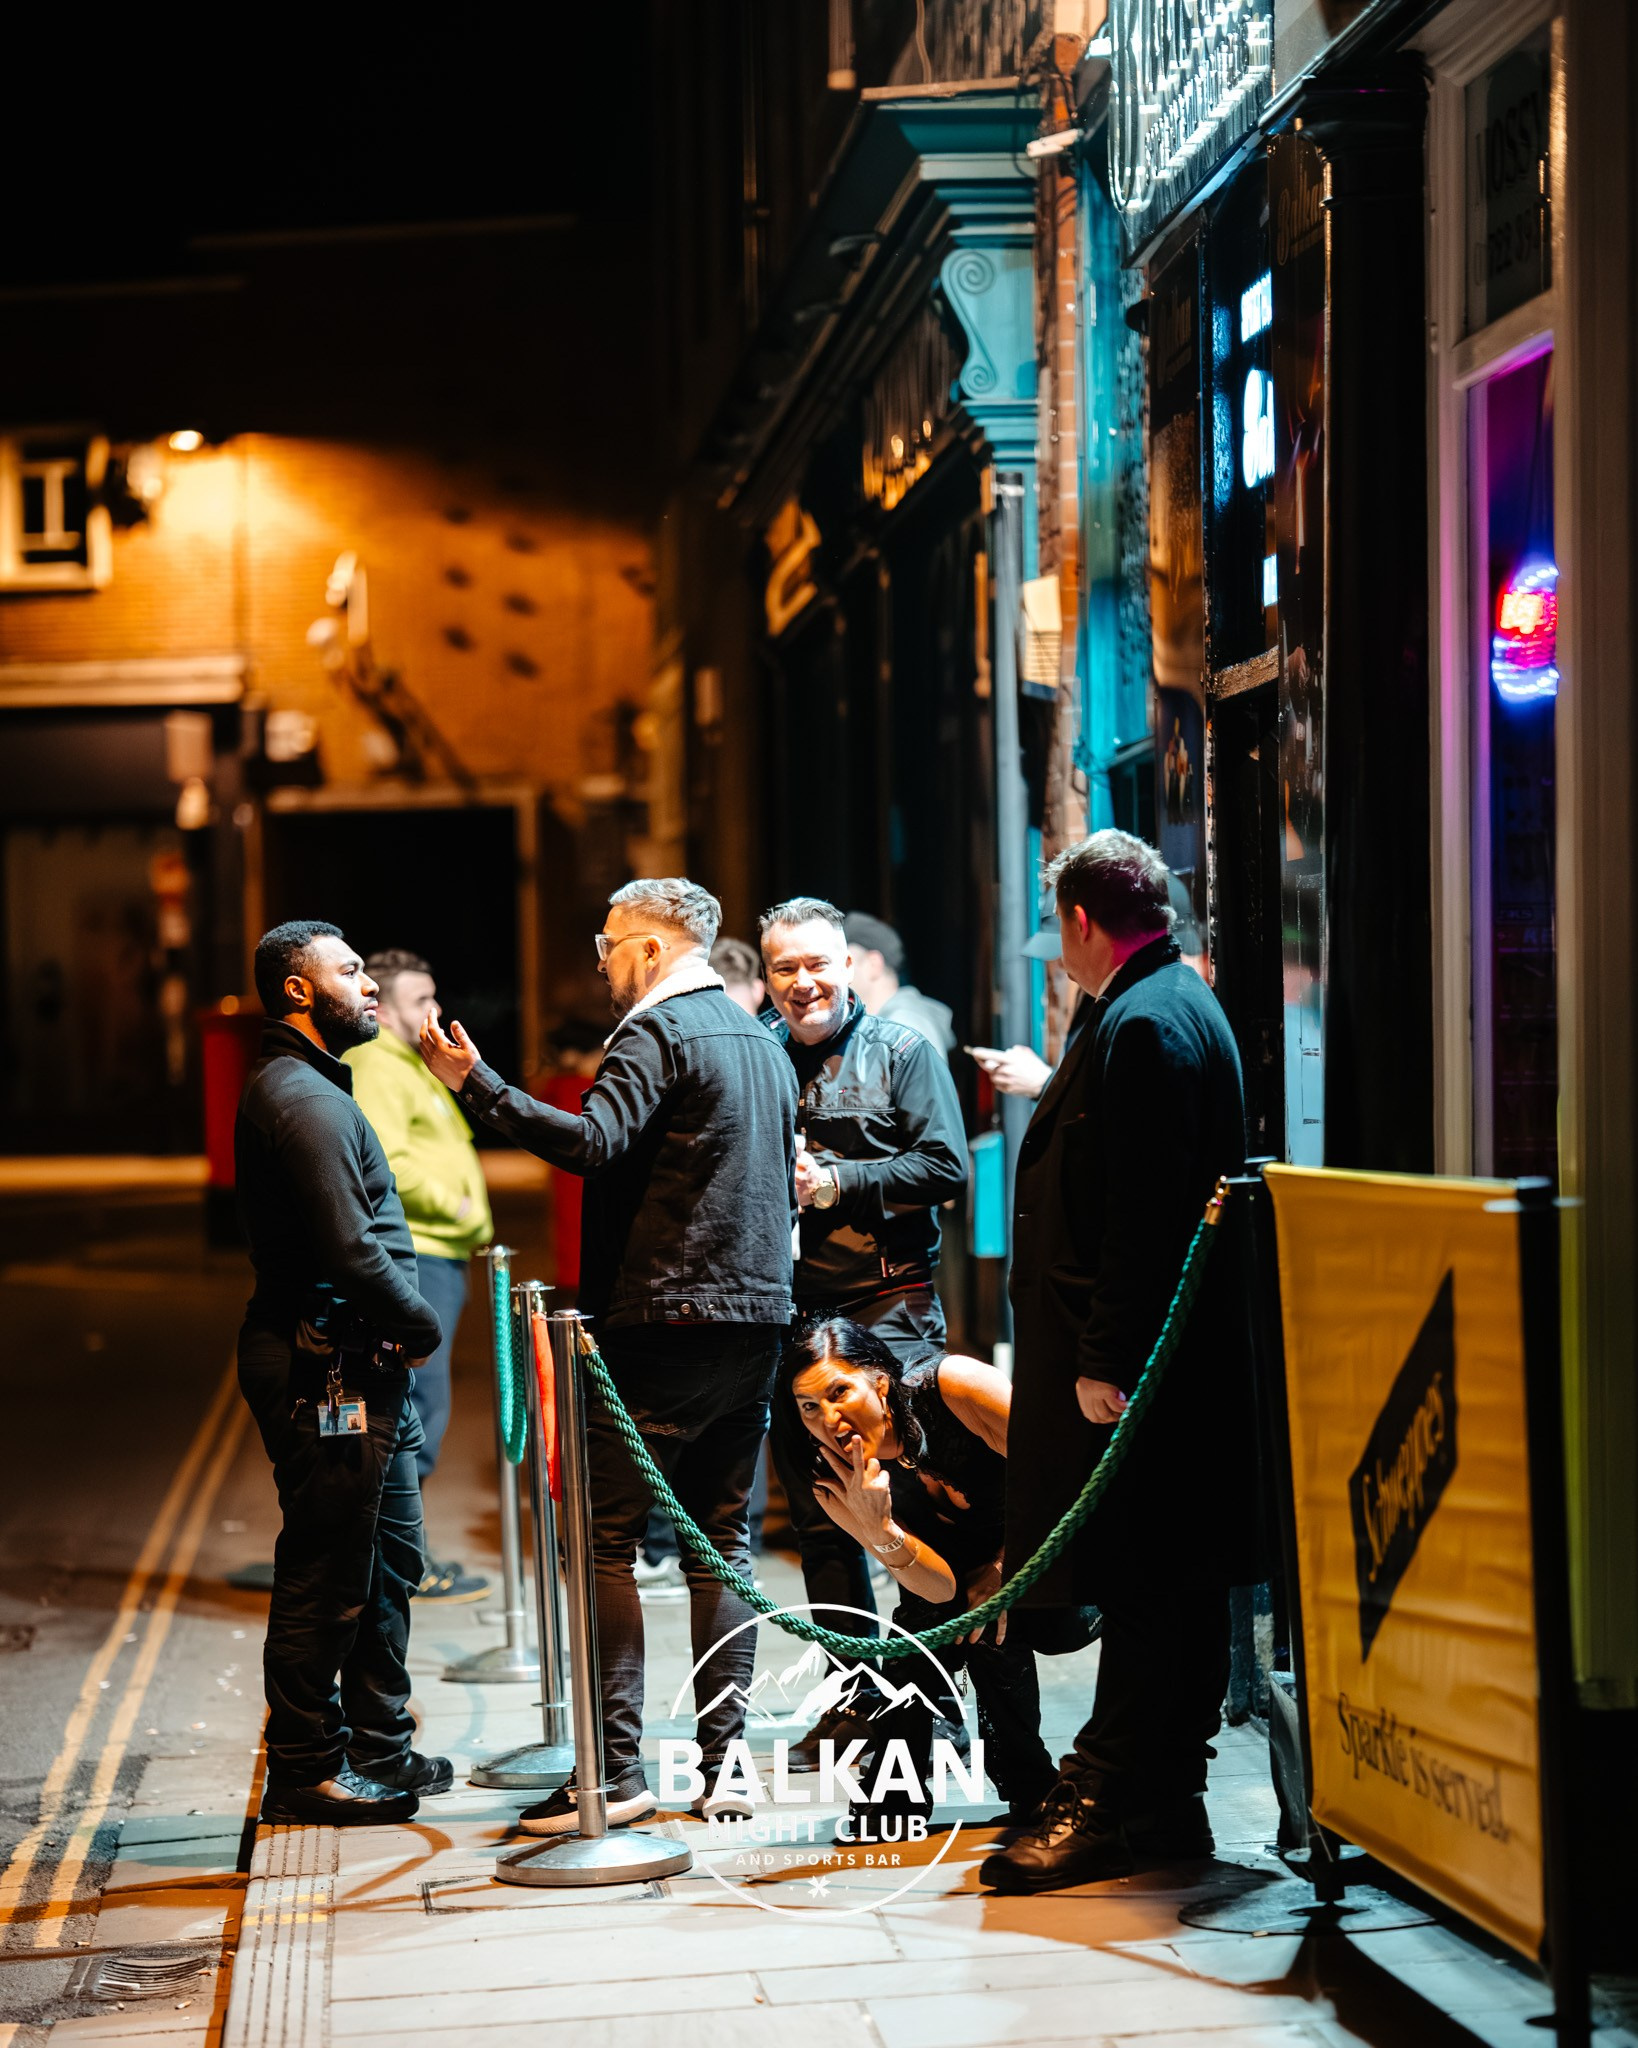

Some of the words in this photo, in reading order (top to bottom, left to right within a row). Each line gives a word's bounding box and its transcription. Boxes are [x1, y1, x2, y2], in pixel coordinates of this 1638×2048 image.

[1362, 1371, 1445, 1583] Schweppes
[1338, 1692, 1409, 1786] Sparkle
[1410, 1727, 1431, 1799] is
